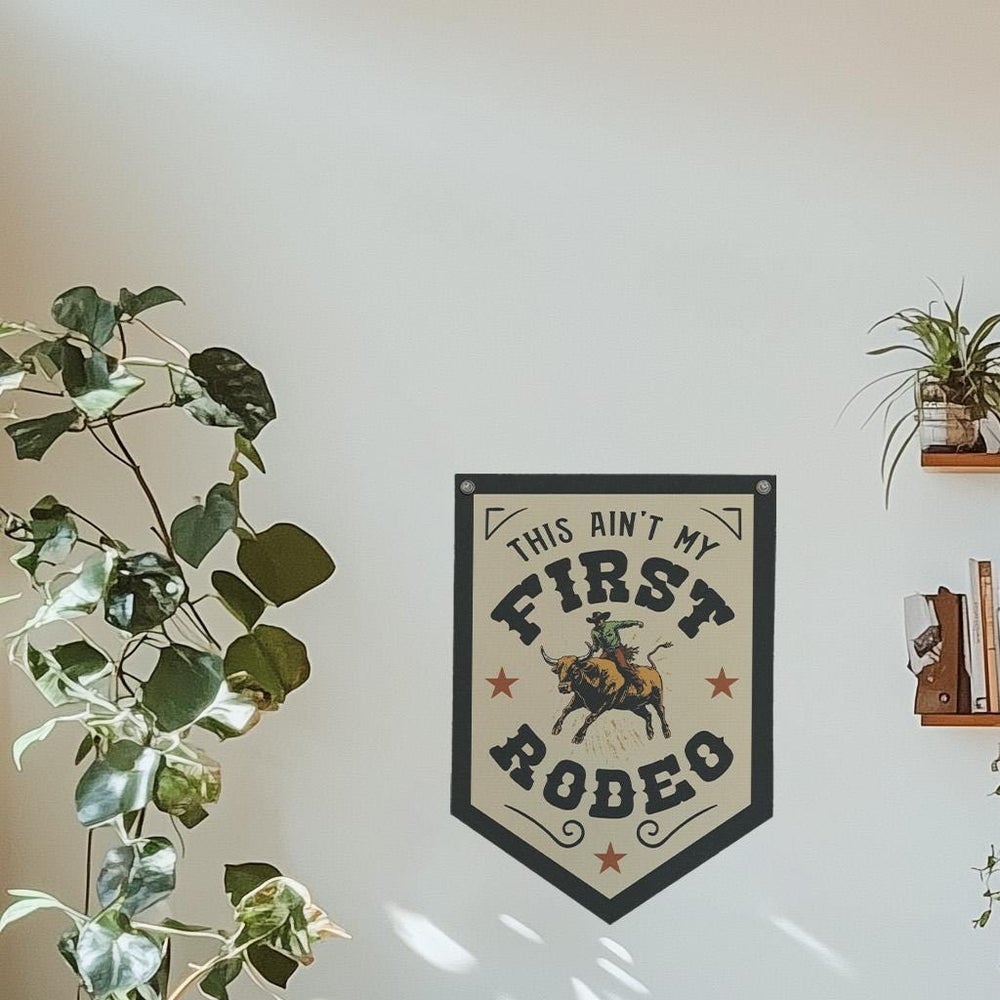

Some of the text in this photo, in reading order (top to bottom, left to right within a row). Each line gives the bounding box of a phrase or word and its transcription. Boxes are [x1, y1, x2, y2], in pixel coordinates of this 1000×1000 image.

[506, 510, 721, 562] THIS AIN'T MY
[490, 548, 736, 647] FIRST
[488, 722, 735, 820] RODEO
